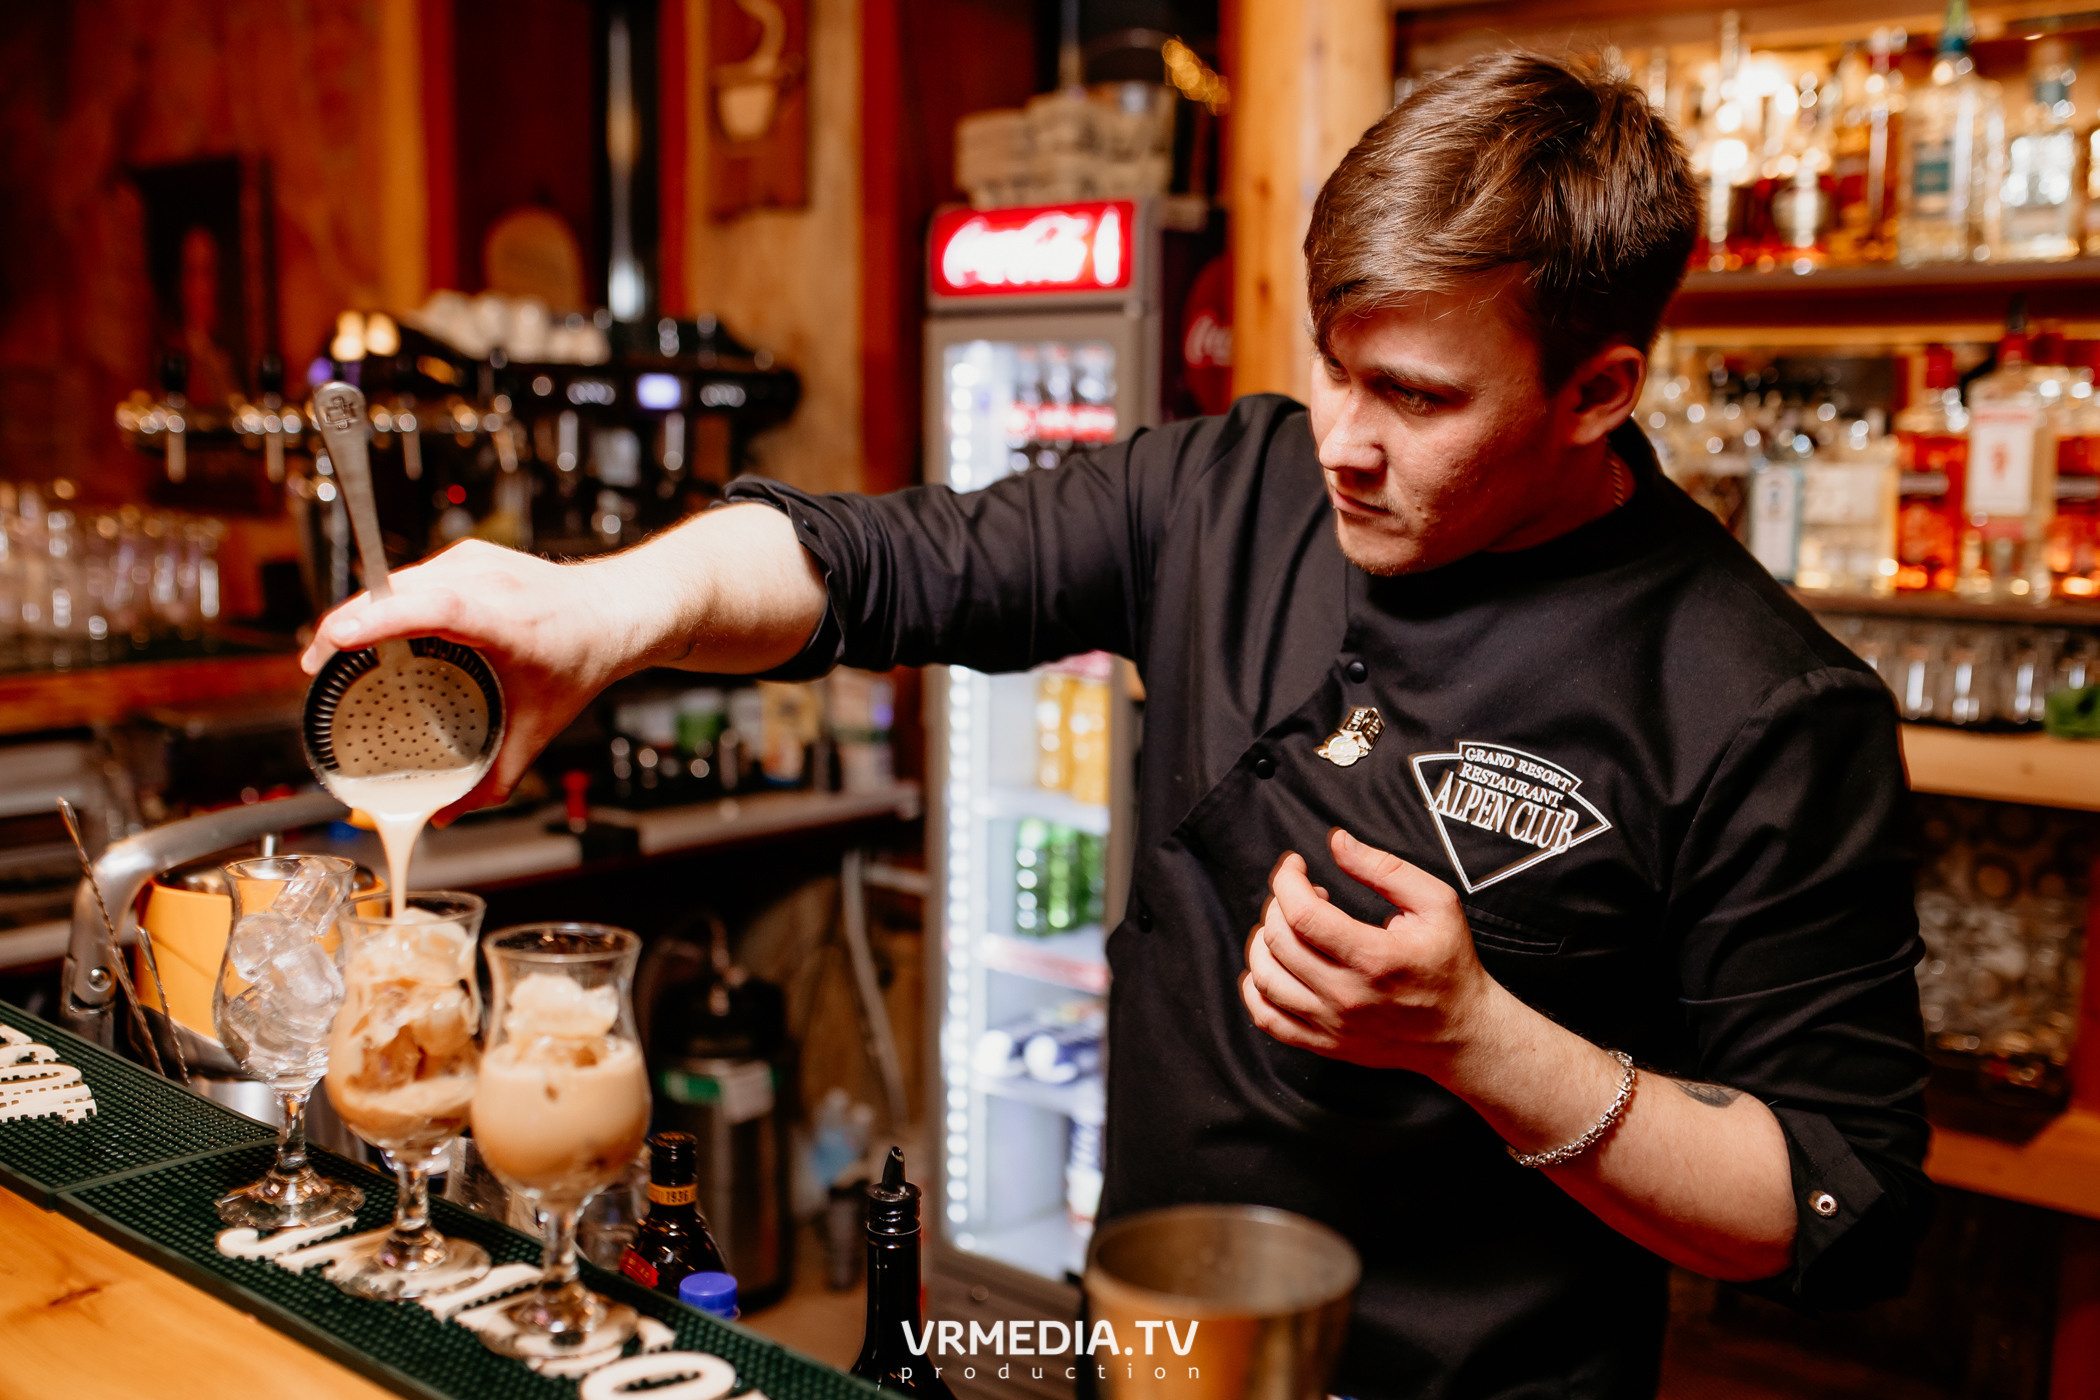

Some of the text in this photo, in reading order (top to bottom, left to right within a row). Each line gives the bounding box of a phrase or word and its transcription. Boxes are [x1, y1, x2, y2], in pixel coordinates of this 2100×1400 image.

[1458, 761, 1565, 808] RESTAURANT
[1464, 747, 1572, 792] GRAND RESORT
[1429, 770, 1580, 854] ALPEN CLUB
